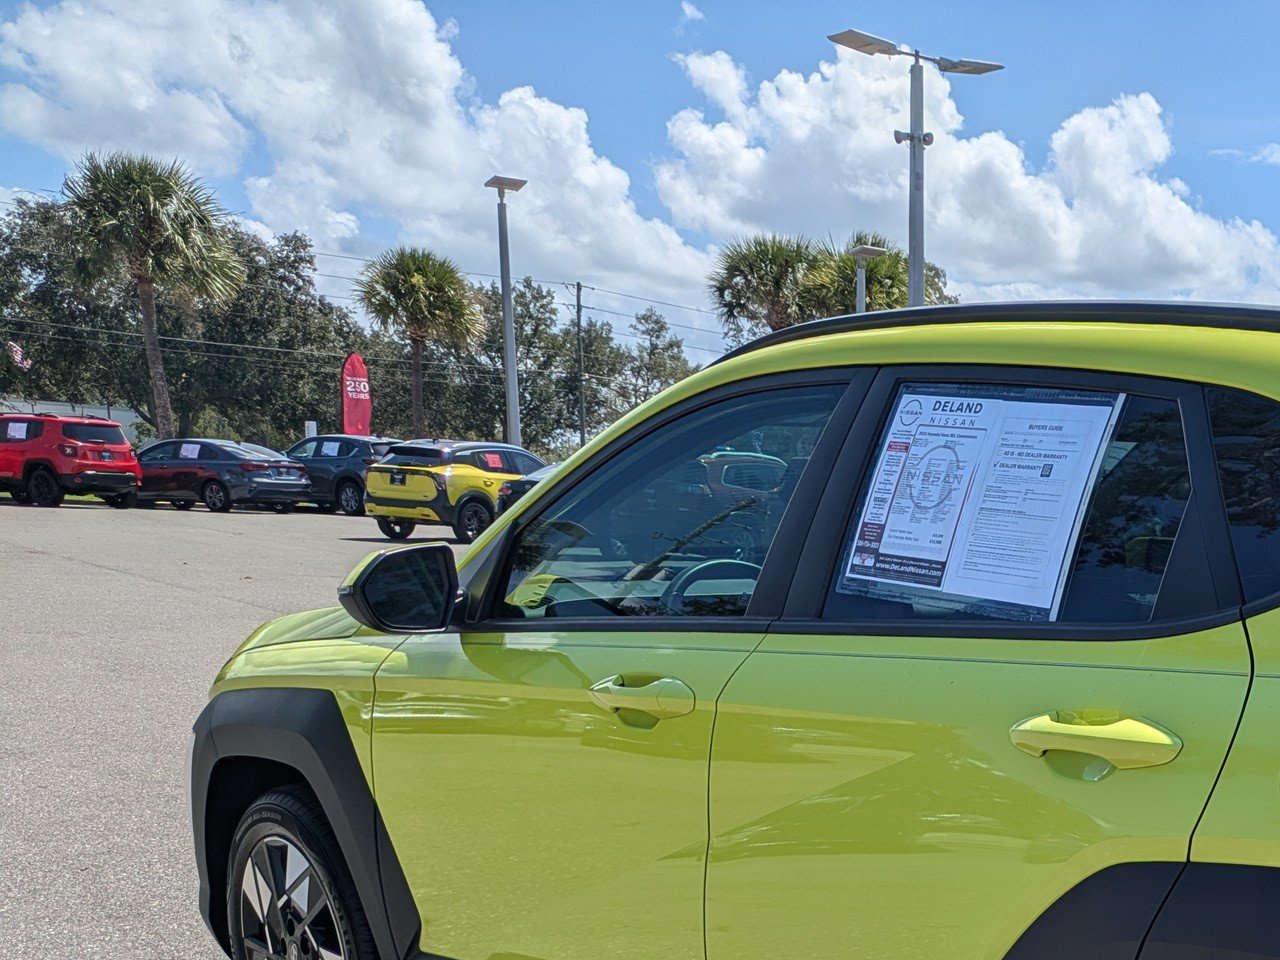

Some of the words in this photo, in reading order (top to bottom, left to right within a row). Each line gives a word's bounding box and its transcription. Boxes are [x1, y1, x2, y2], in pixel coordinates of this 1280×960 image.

[346, 380, 369, 392] 250
[932, 400, 983, 414] DELAND
[929, 416, 976, 427] NISSAN
[1048, 424, 1064, 432] GUIDE
[1017, 463, 1042, 471] WARRANTY
[906, 470, 963, 485] NISSAN
